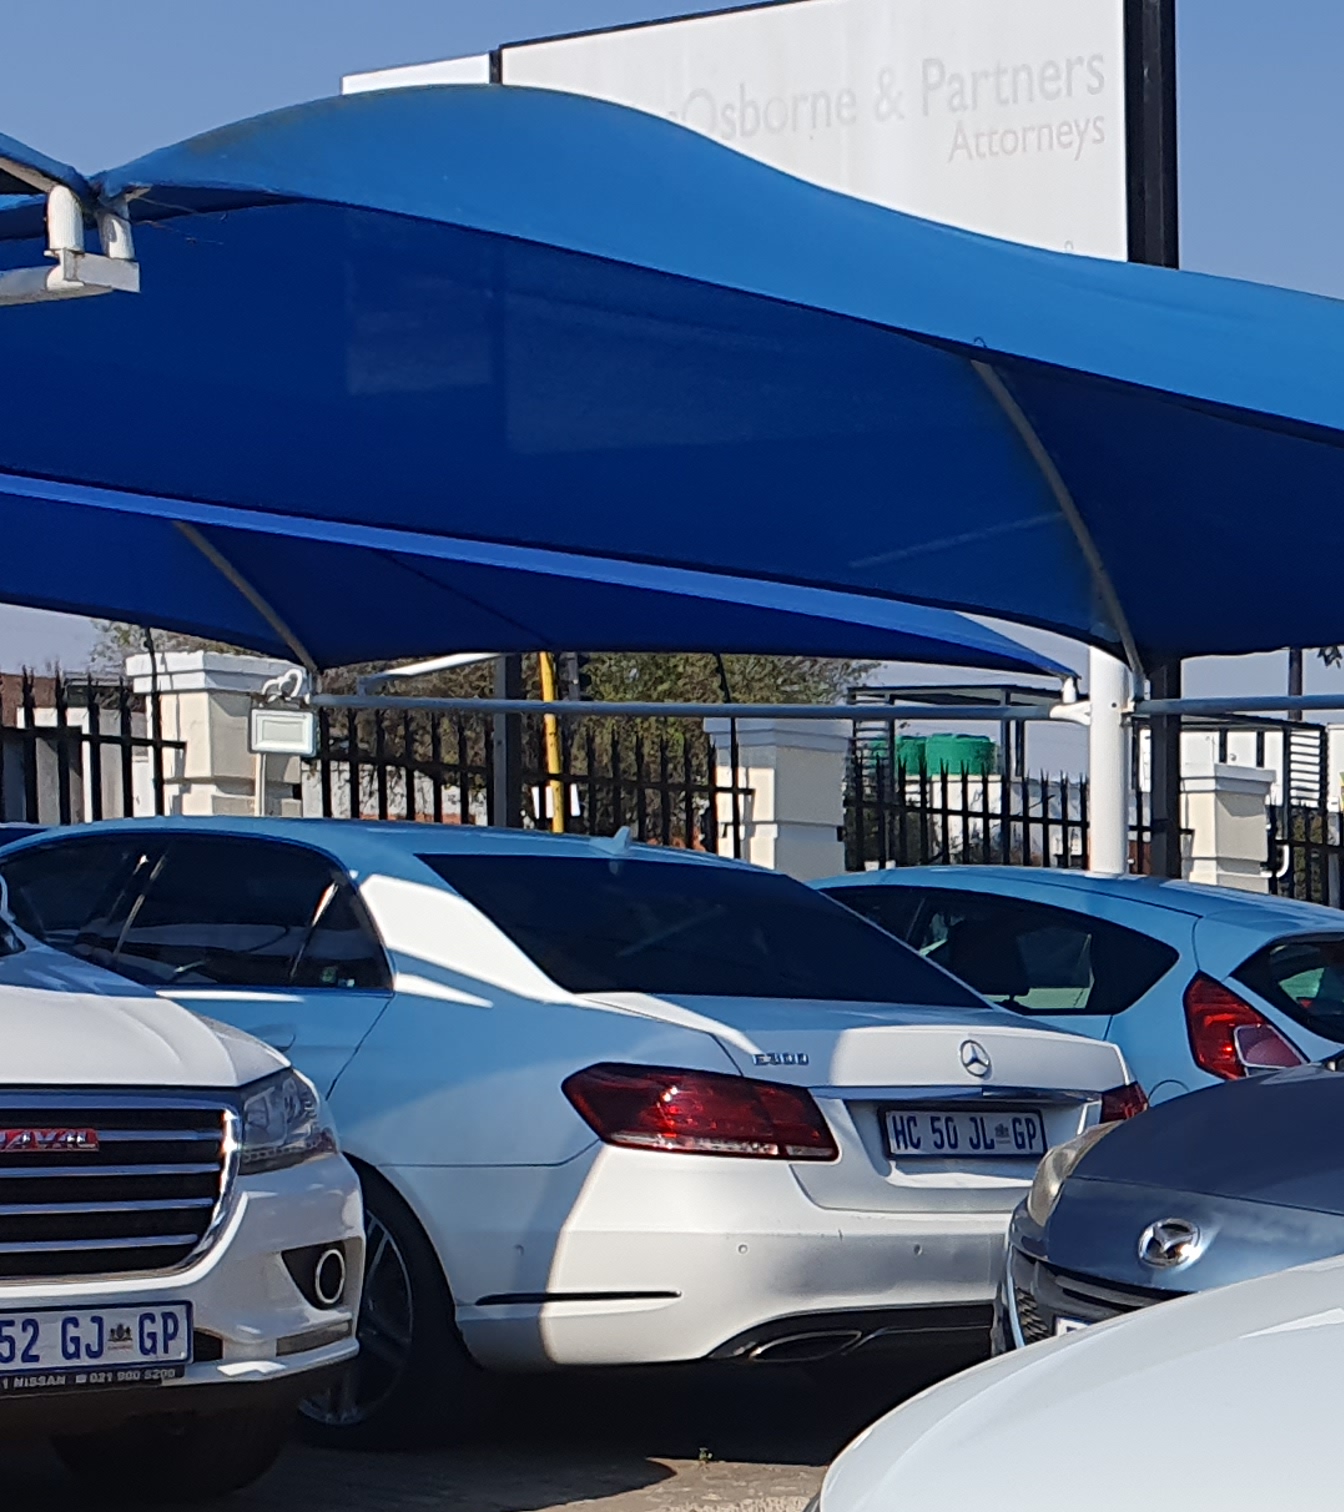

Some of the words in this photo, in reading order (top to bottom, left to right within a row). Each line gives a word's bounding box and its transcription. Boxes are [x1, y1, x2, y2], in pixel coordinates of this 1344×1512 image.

[873, 65, 905, 122] &
[920, 51, 1106, 117] Partners
[947, 113, 1107, 162] Attorneys
[0, 1130, 97, 1150] AVAL
[891, 1115, 921, 1150] HC
[930, 1115, 959, 1150] 50
[968, 1116, 995, 1150] JL
[1011, 1116, 1037, 1150] GP
[0, 1318, 40, 1364] 52
[61, 1315, 105, 1361] GJ
[138, 1311, 180, 1356] GP
[13, 1375, 66, 1388] NISSAN
